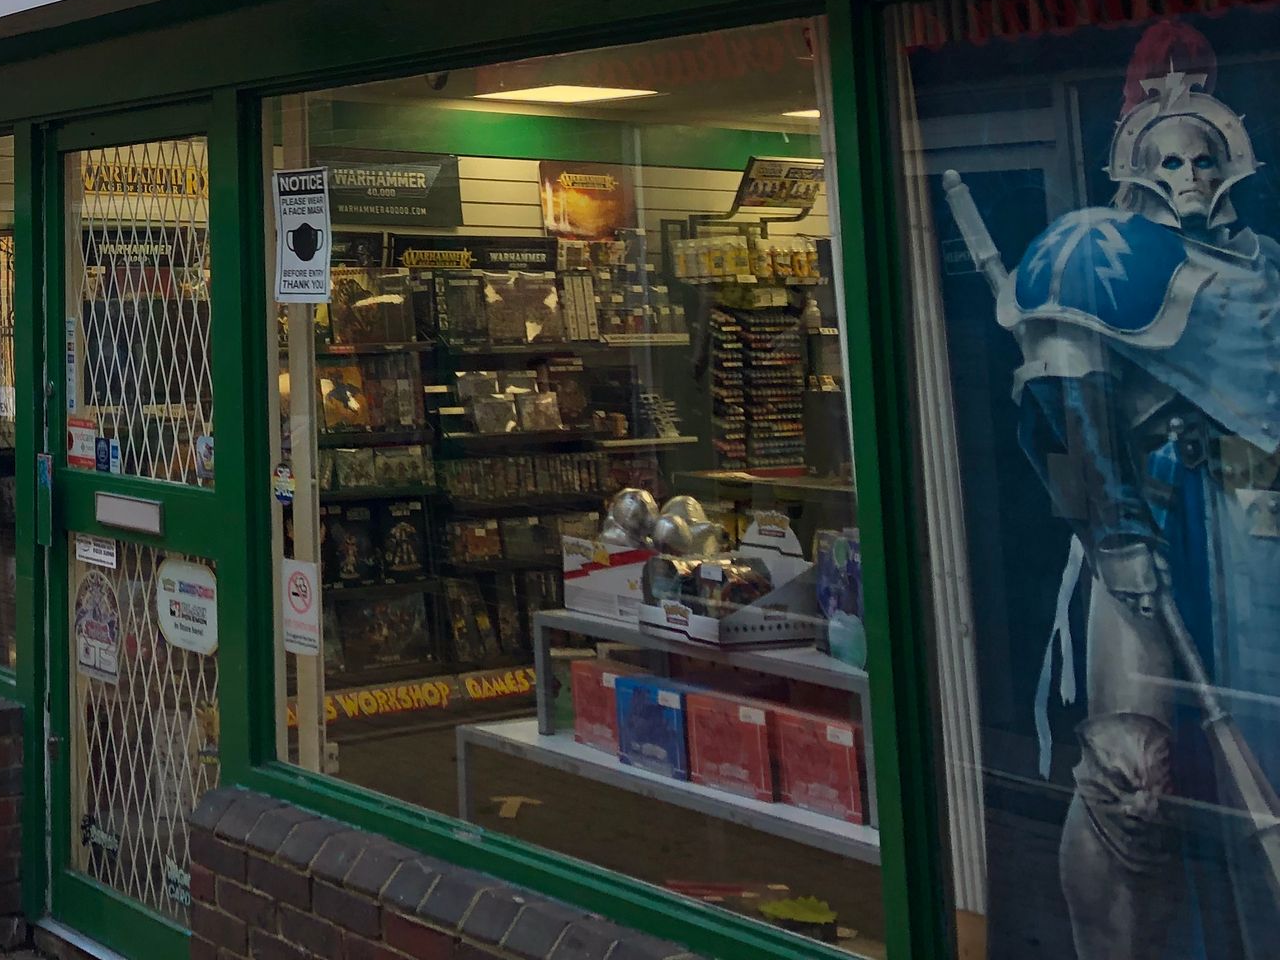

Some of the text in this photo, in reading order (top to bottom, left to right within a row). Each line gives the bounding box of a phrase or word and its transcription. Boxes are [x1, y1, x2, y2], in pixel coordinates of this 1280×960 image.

[334, 168, 426, 188] WARHAMMER
[280, 175, 324, 192] NOTICE
[282, 196, 323, 206] PLEASE WEAR
[289, 207, 305, 215] FACE
[307, 206, 324, 215] MASK
[338, 205, 427, 215] WARHAMMER40000.COM
[489, 252, 547, 263] WARHAMMER
[283, 269, 324, 278] BEFORE ENTRY
[282, 280, 324, 289] THANK YOU
[464, 670, 531, 701] GAMES
[335, 681, 451, 719] WORKSHOP
